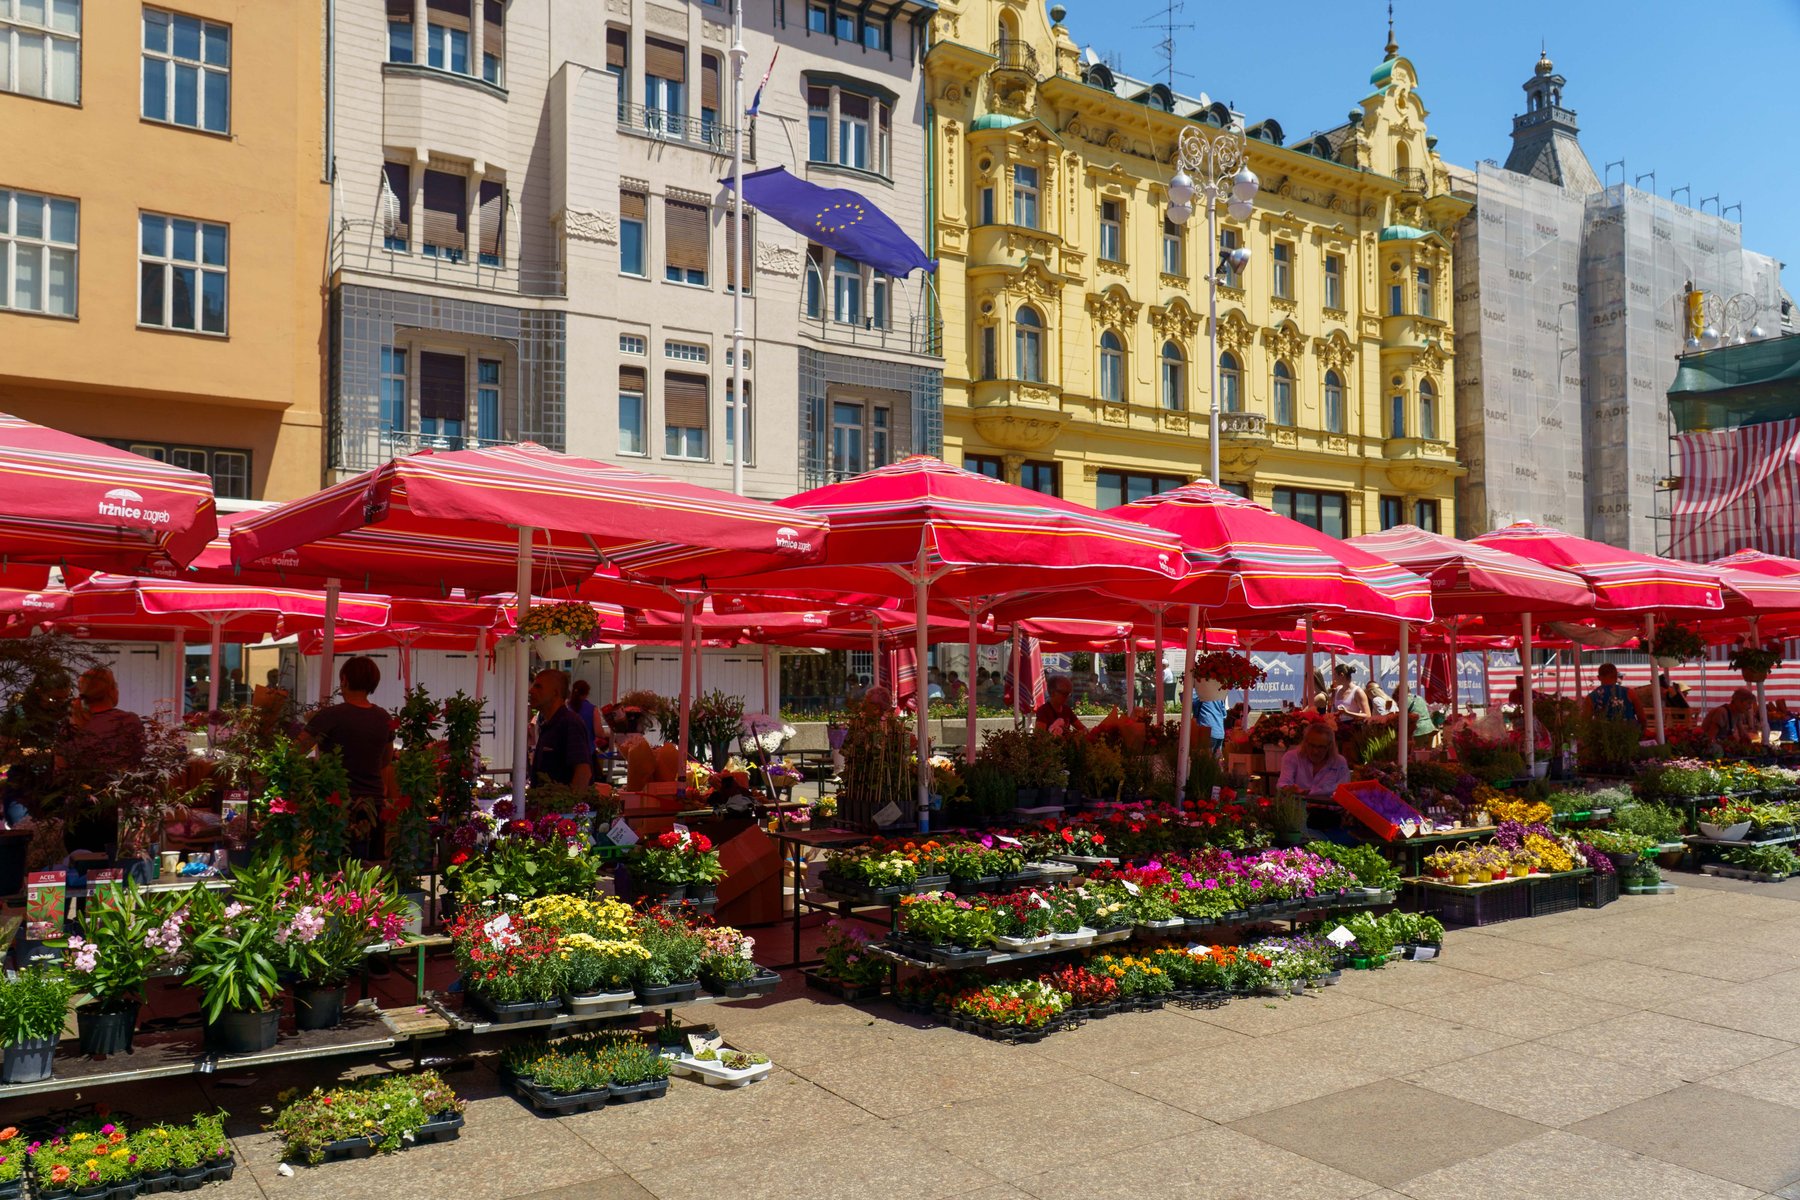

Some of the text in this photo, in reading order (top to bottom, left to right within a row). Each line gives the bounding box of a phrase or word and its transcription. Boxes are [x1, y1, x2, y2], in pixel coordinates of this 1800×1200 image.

[99, 501, 141, 518] tržnice
[1256, 681, 1280, 692] PROJEKT
[1281, 681, 1295, 691] d.o.o.
